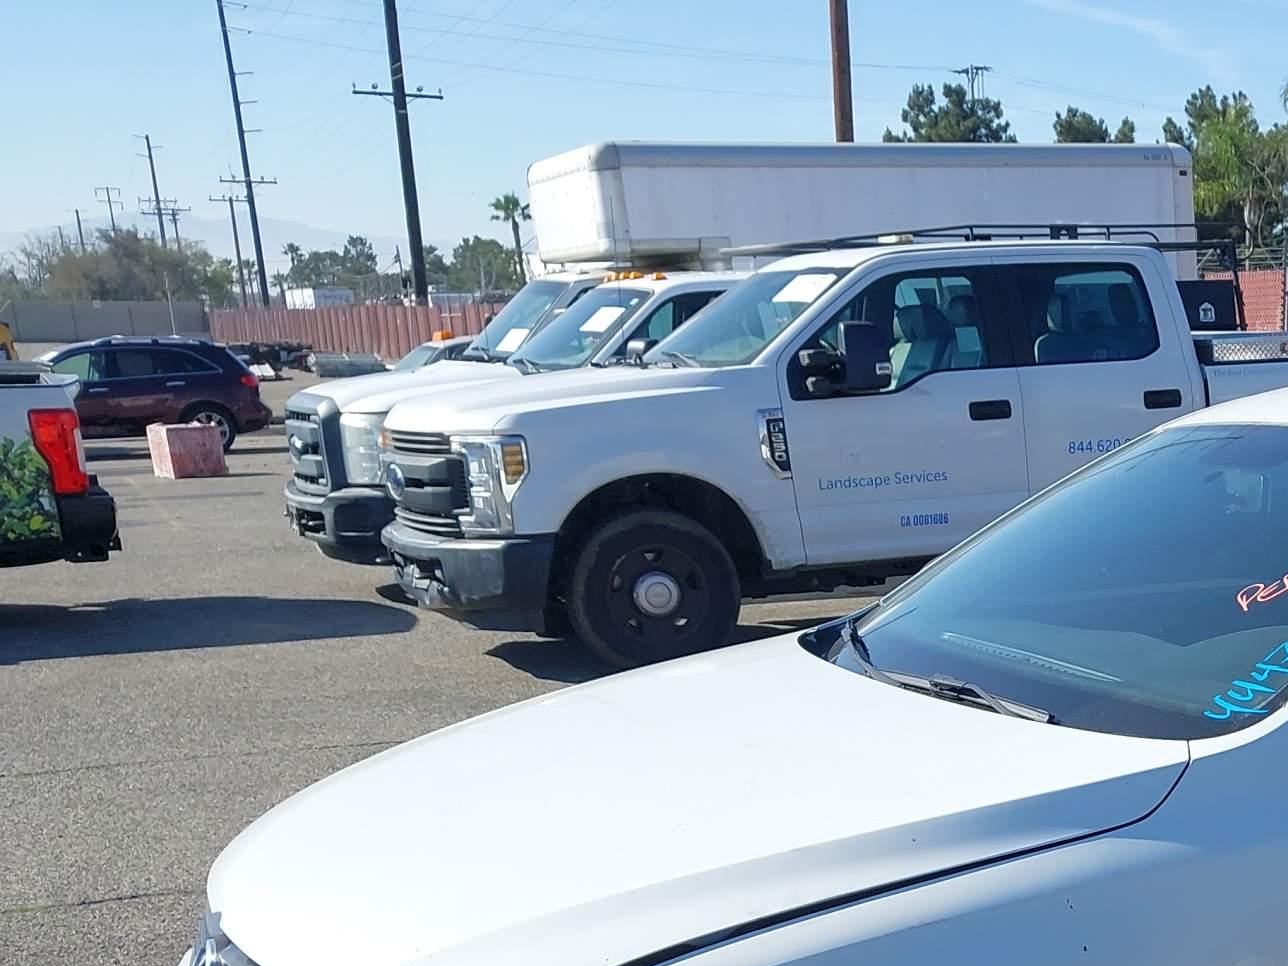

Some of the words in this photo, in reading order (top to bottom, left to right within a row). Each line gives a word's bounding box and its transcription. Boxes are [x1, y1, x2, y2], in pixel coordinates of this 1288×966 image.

[818, 475, 891, 490] Landscape
[894, 470, 948, 485] Services
[900, 515, 911, 527] CA
